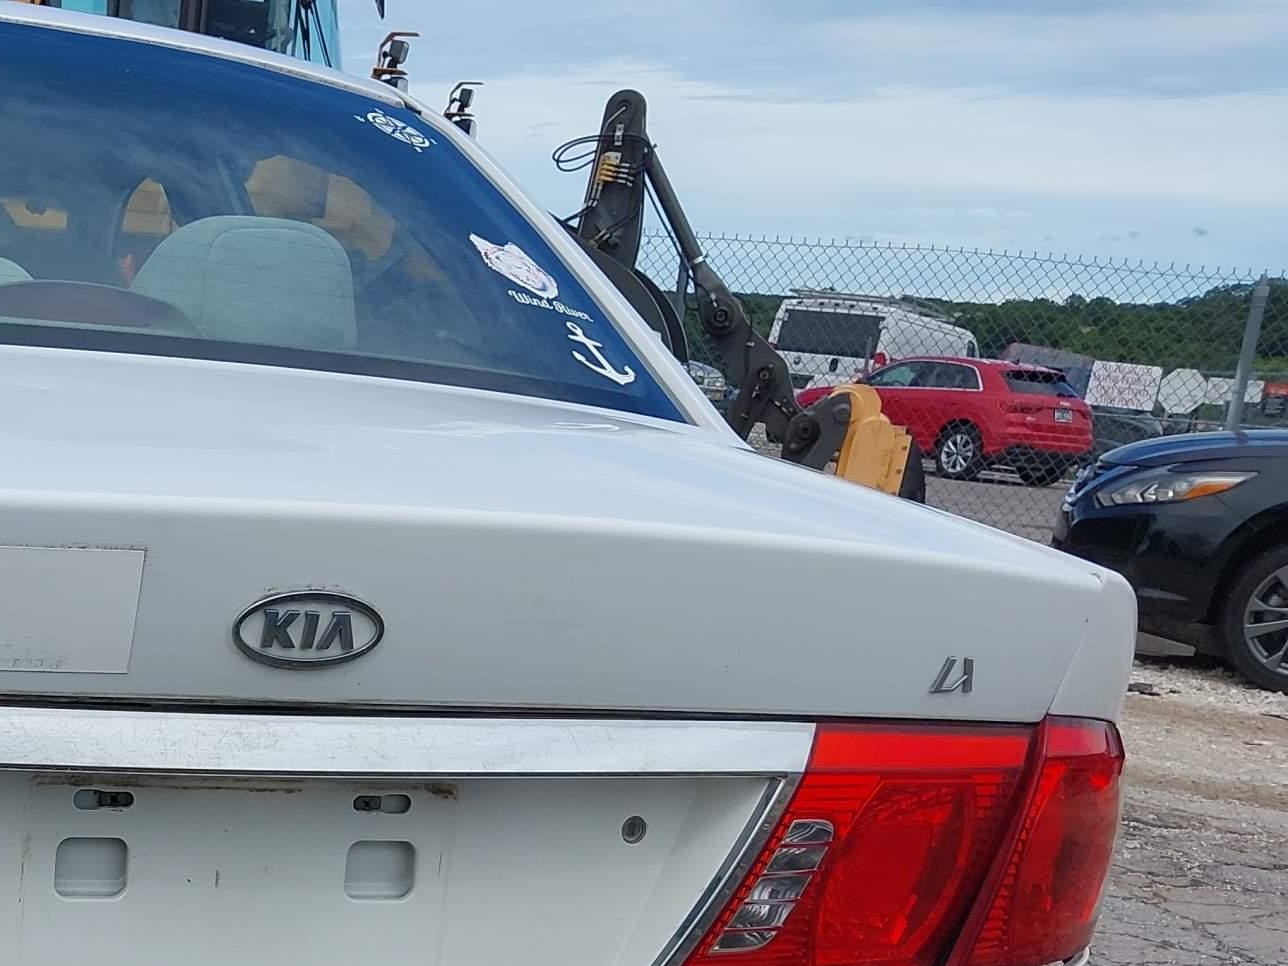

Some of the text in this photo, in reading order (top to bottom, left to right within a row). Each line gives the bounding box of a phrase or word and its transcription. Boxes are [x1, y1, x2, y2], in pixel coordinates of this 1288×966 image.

[507, 289, 594, 322] Wind River
[260, 608, 355, 650] KIA
